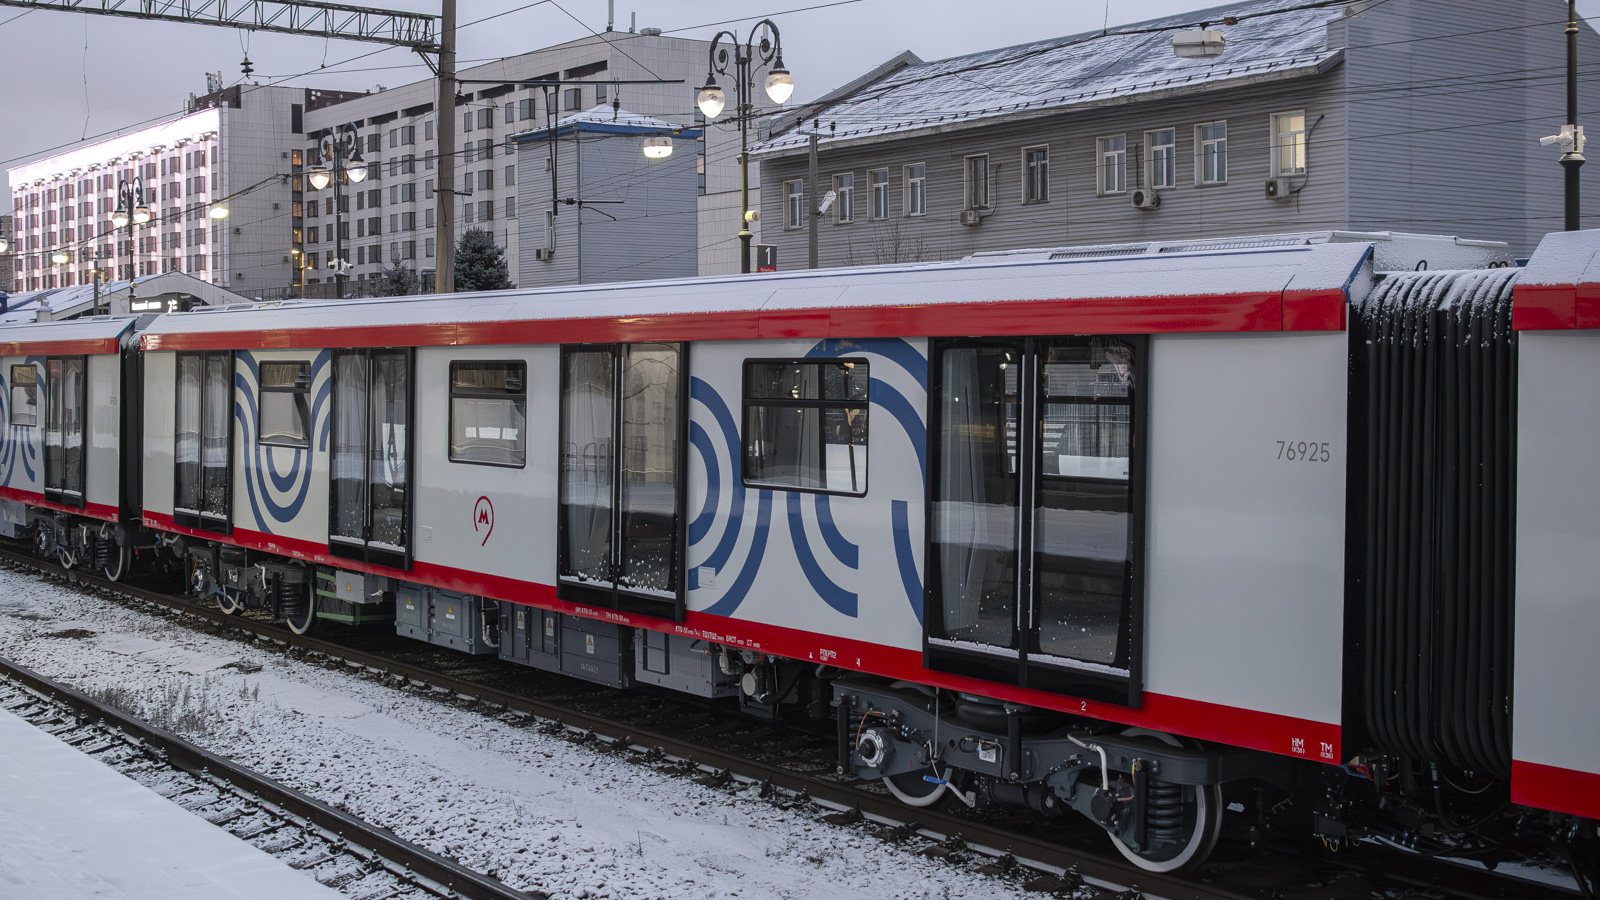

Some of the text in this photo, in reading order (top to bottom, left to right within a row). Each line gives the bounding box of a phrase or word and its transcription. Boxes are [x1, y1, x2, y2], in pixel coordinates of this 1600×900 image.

[765, 246, 771, 265] 1
[1276, 440, 1330, 463] 76925
[856, 657, 861, 667] 4
[1080, 700, 1086, 711] 2
[1291, 737, 1304, 748] НМ
[1320, 742, 1333, 753] ТМ
